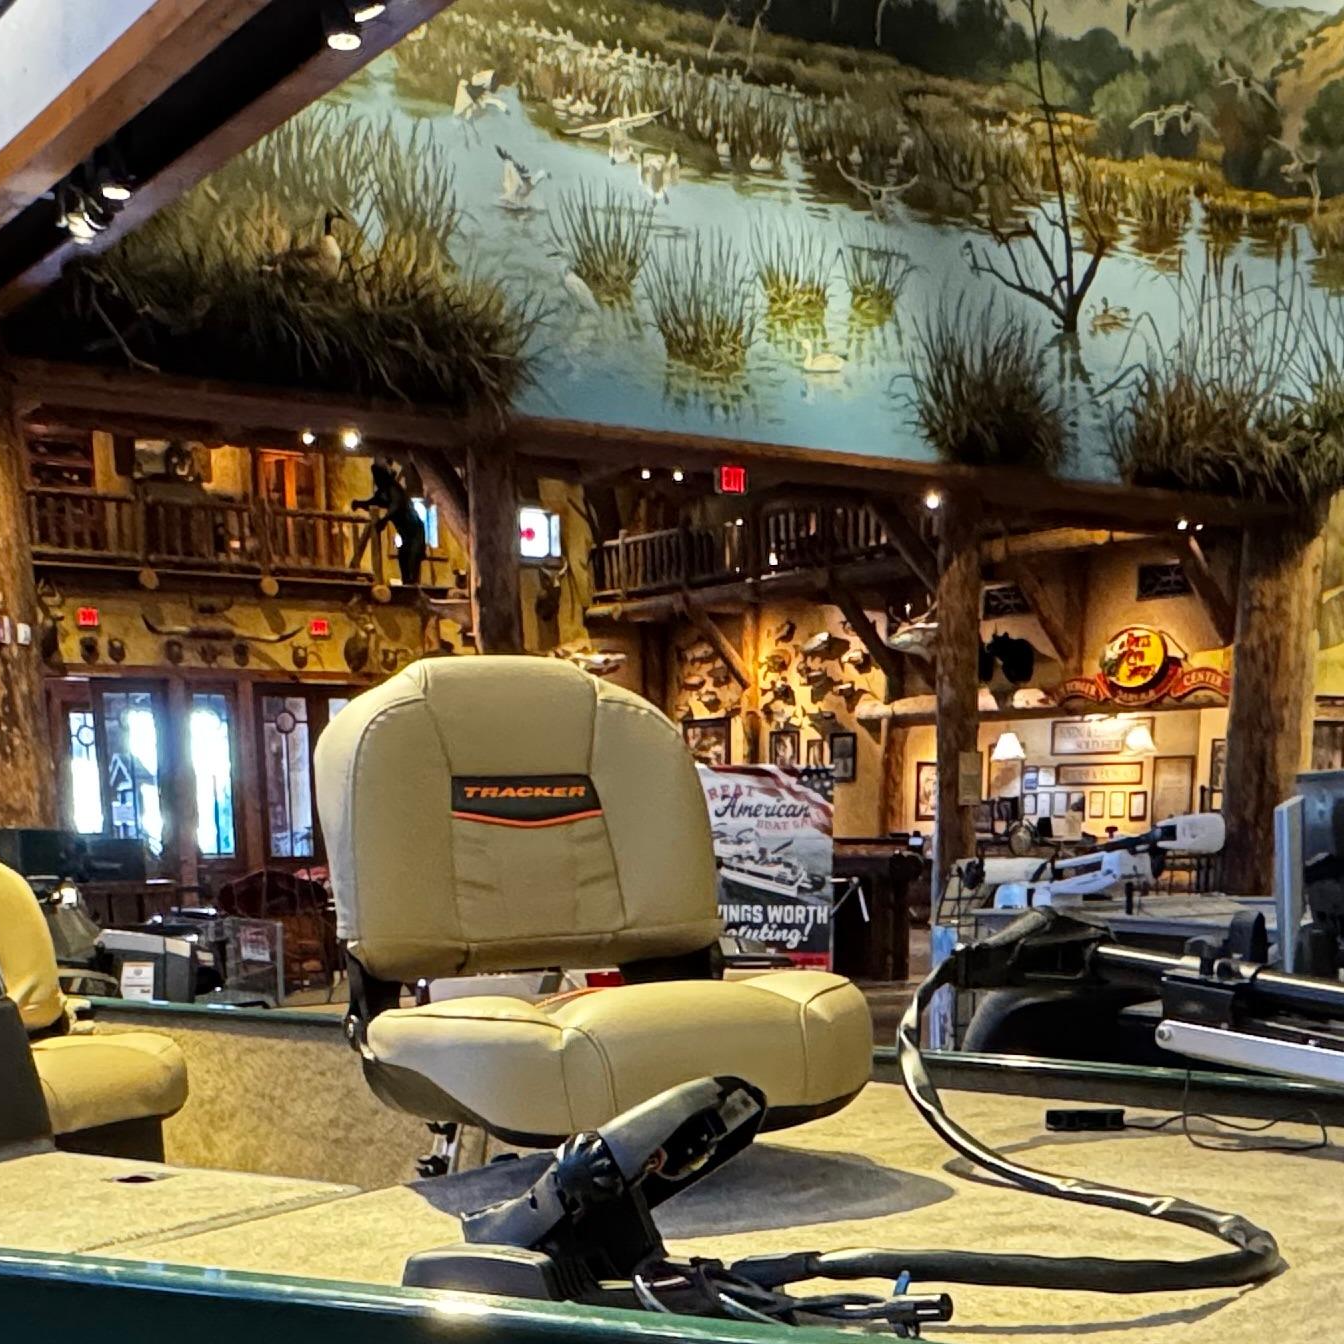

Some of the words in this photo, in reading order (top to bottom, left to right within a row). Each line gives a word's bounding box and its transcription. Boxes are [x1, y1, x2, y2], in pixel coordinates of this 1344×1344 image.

[464, 786, 586, 798] TRACKER
[708, 784, 754, 800] REAT
[715, 794, 811, 818] American
[767, 904, 828, 924] WORTH
